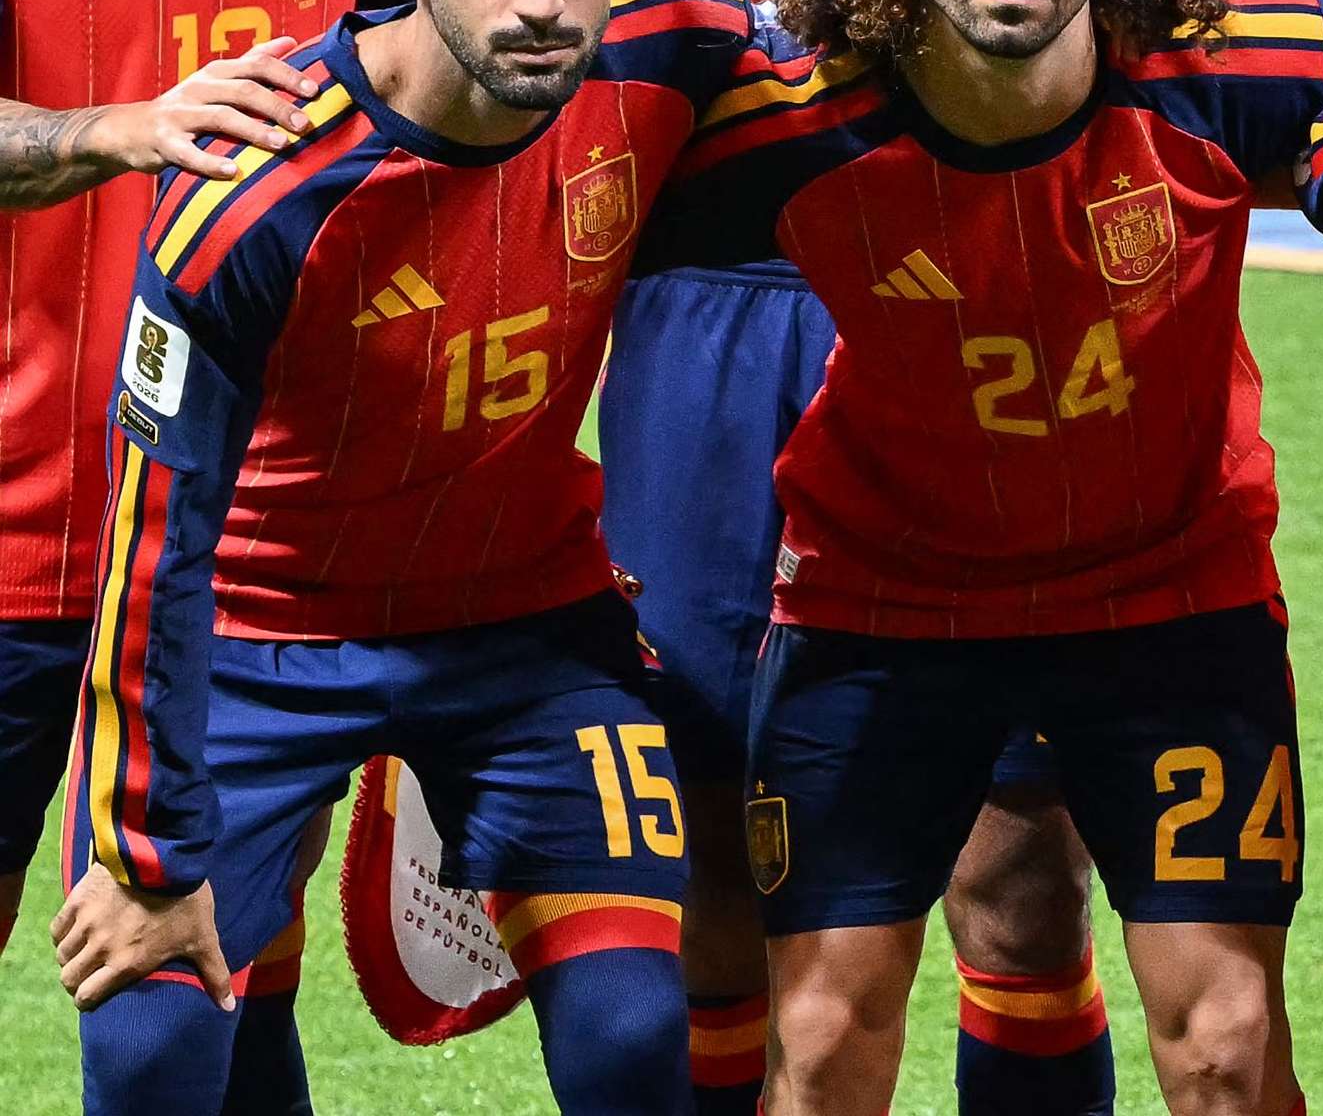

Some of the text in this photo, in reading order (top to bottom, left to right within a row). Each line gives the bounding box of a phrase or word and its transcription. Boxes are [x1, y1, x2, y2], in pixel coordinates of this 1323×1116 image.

[443, 304, 552, 432] 15
[961, 318, 1137, 437] 24
[573, 723, 686, 860] 15
[1152, 744, 1300, 884] 24
[404, 908, 503, 978] DE FÚTBOL
